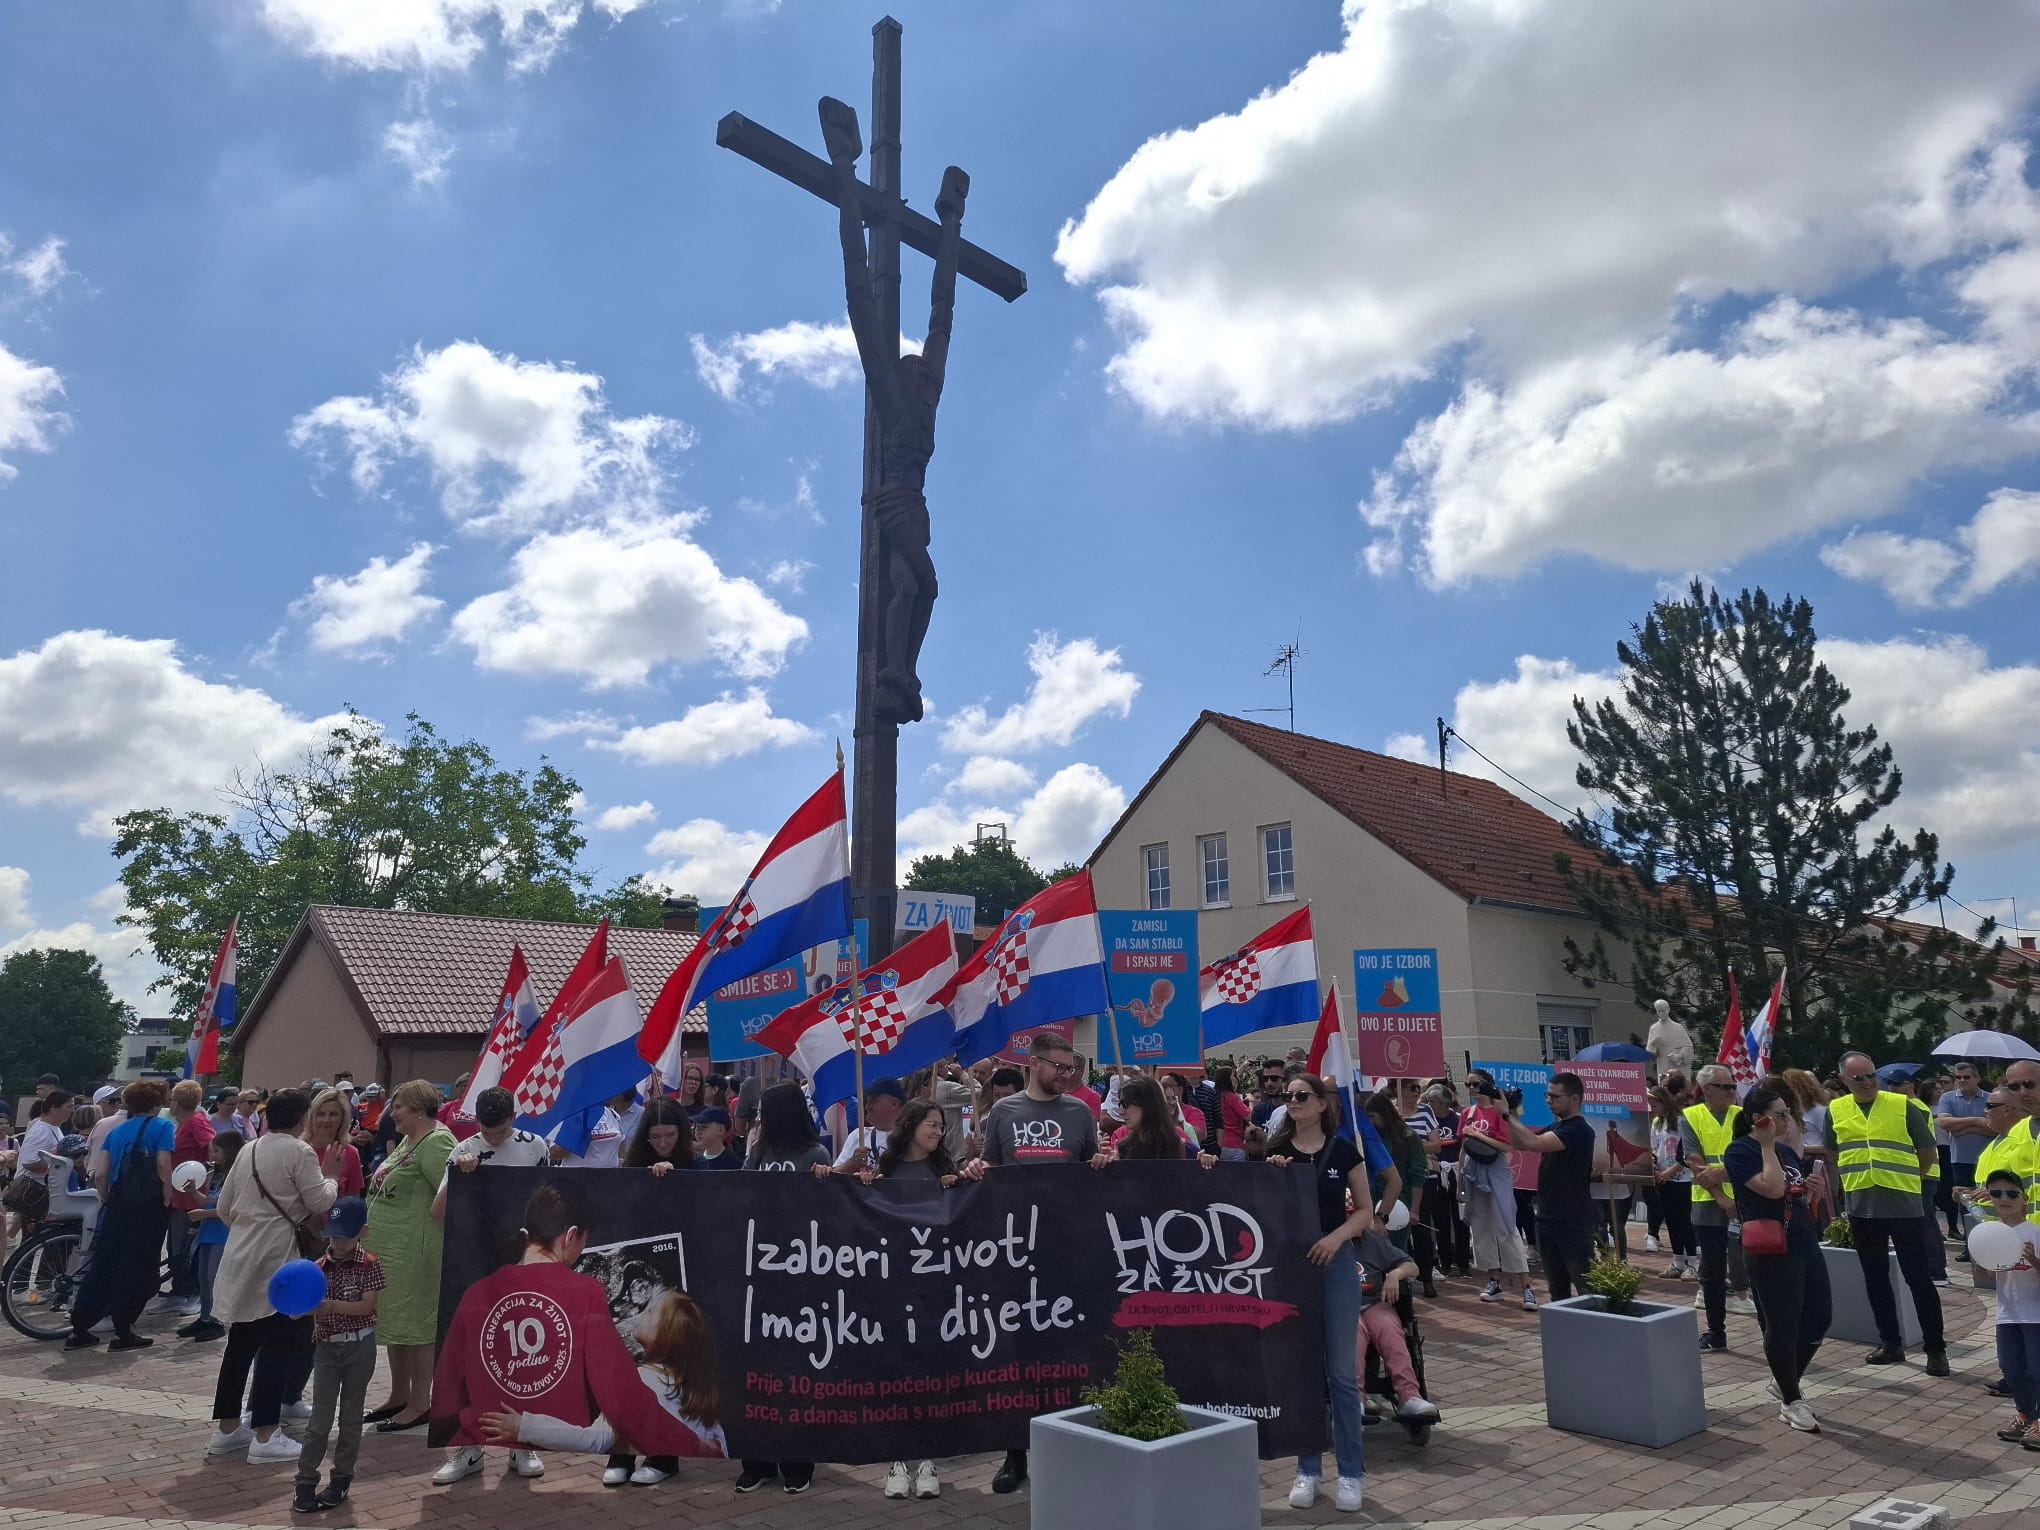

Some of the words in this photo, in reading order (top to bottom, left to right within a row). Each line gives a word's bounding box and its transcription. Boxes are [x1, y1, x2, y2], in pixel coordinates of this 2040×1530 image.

[904, 902, 928, 927] ZA
[1131, 920, 1168, 932] ZAMISLI
[1115, 938, 1128, 950] DA
[1130, 938, 1150, 950] SAM
[1151, 938, 1183, 950] STABLO
[1126, 956, 1130, 968] I
[1132, 955, 1158, 968] SPASI
[1160, 955, 1174, 968] ME
[1360, 955, 1378, 969] OVO
[1381, 955, 1393, 969] JE
[1396, 954, 1431, 969] IZBOR
[719, 975, 760, 998] SMIJE
[763, 973, 779, 992] SE
[1361, 1017, 1379, 1031] OVO
[1382, 1017, 1395, 1032] JE
[1398, 1017, 1437, 1032] DIJETE
[1132, 1033, 1163, 1048] HOD
[1498, 1067, 1511, 1082] JE
[1513, 1068, 1548, 1085] IZBOR
[1577, 1067, 1596, 1077] MOŽE
[1597, 1068, 1640, 1079] IZVANREDNE
[1013, 1120, 1062, 1140] HOD
[1014, 1136, 1029, 1146] ZA
[1031, 1137, 1065, 1149] ŽIVOT
[652, 1242, 677, 1253] 2016.
[745, 1218, 889, 1279] Izaberi
[910, 1204, 1039, 1275] život!
[1105, 1202, 1264, 1271] HOD
[1115, 1260, 1165, 1294] ZA
[1171, 1262, 1274, 1300] ŽIVOT
[1128, 1305, 1140, 1315] ZA
[486, 1297, 526, 1350] GENERACIJA
[528, 1297, 544, 1310] ZA
[544, 1304, 567, 1339] ŽIVOT
[744, 1284, 753, 1343] I
[761, 1288, 884, 1369] majku
[905, 1304, 916, 1344] i
[940, 1276, 1086, 1359] dijete.
[502, 1317, 546, 1357] 10
[506, 1379, 521, 1393] HOD
[522, 1384, 533, 1393] ZA
[532, 1372, 555, 1392] ŽIVOT
[554, 1348, 567, 1371] 2025.
[507, 1353, 551, 1377] godina
[746, 1372, 784, 1395] Prije
[789, 1375, 811, 1394] 10
[814, 1378, 875, 1399] godina
[880, 1376, 941, 1397] počelo
[946, 1372, 960, 1394] je
[965, 1363, 1020, 1385] kucati
[1025, 1360, 1089, 1383] njezino
[745, 1403, 783, 1425] srce,
[789, 1408, 800, 1423] a
[804, 1405, 857, 1424] danas
[862, 1403, 908, 1424] hoda
[913, 1408, 923, 1420] s
[927, 1400, 982, 1418] nama.
[986, 1388, 1040, 1411] Hodaj
[1045, 1388, 1049, 1405] i
[1054, 1387, 1072, 1406] ti!
